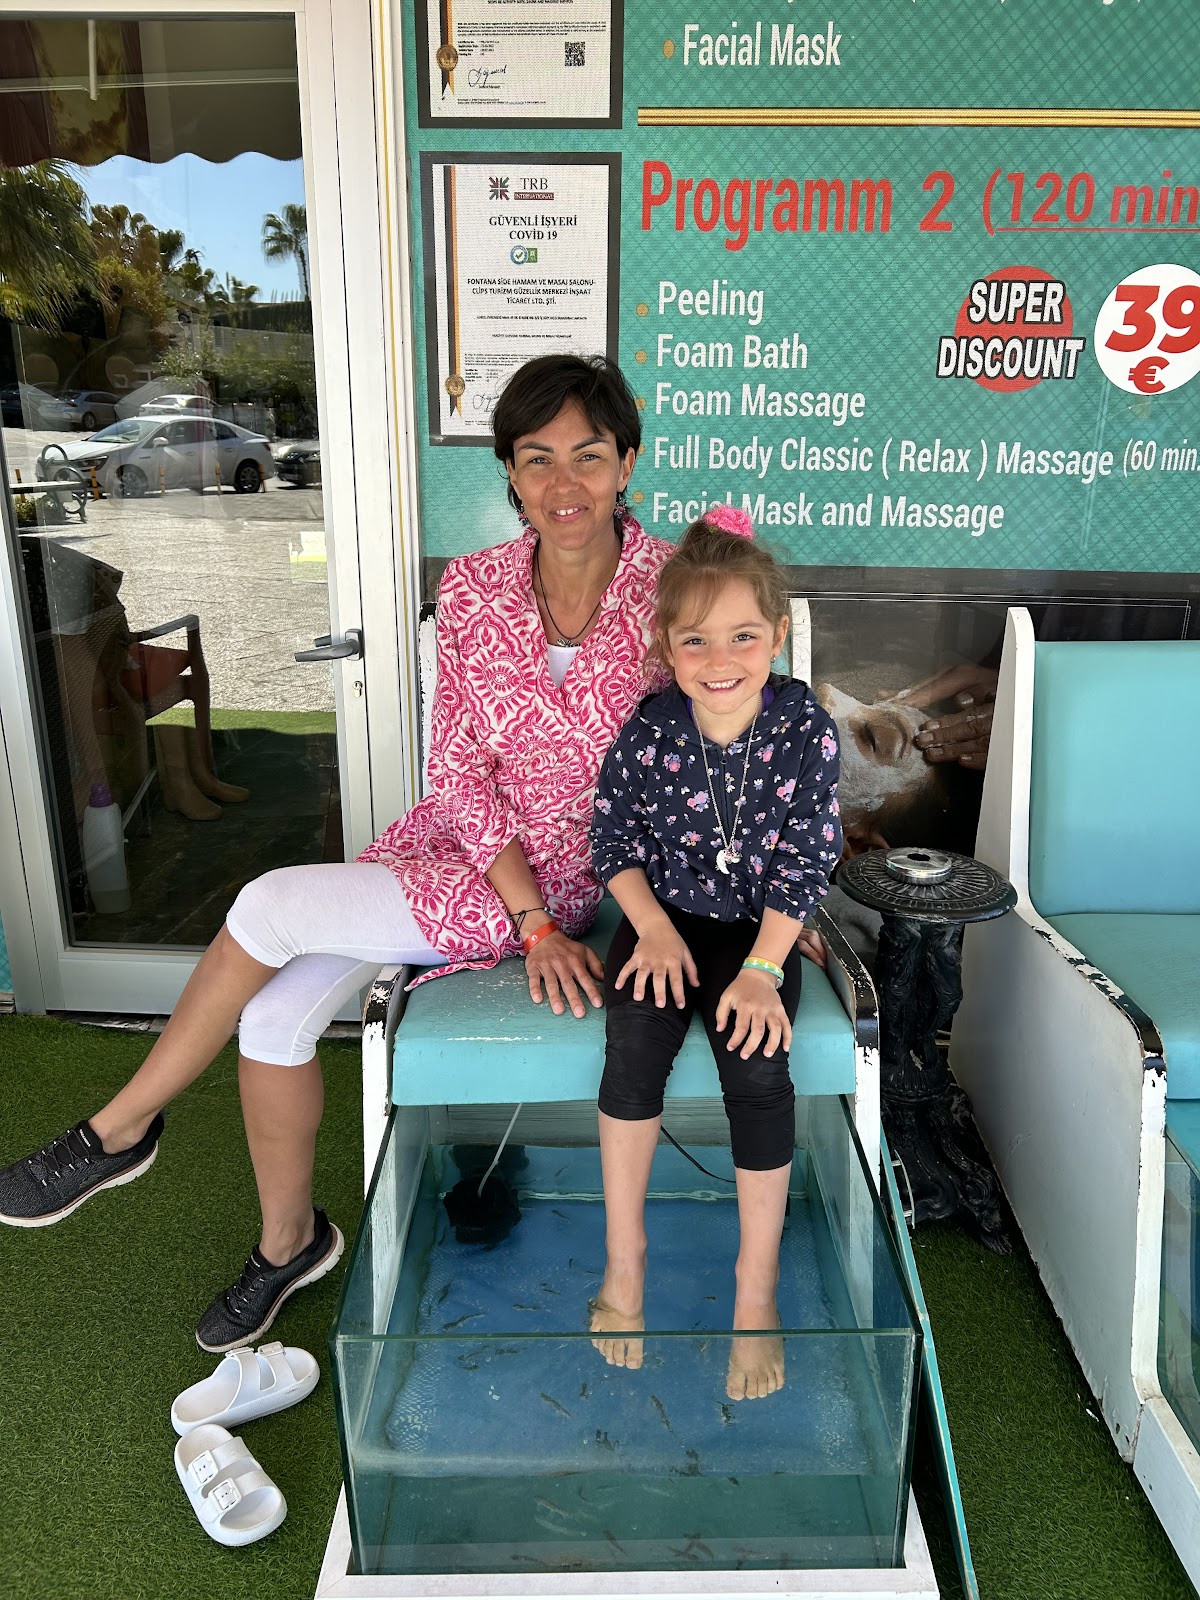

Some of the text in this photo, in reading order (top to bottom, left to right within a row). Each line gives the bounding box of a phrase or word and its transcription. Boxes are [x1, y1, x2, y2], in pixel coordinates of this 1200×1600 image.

[683, 21, 842, 66] Facial Mask
[520, 178, 548, 190] TRB
[641, 160, 893, 251] Programm
[919, 170, 956, 232] 2
[982, 169, 1096, 235] (120
[489, 214, 578, 228] GÜVENLİ İŞYERİ
[548, 230, 557, 240] 19
[512, 278, 537, 286] HAMAM
[658, 279, 764, 325] Peeling
[968, 280, 1066, 324] SUPER
[1104, 285, 1200, 354] 39
[656, 333, 807, 370] Foam Bath
[936, 336, 1086, 380] DISCOUNT
[655, 382, 866, 426] Foam Massage
[654, 435, 700, 470] Full
[708, 436, 774, 478] Body
[780, 437, 873, 473] Classic
[898, 439, 972, 474] Relax
[997, 442, 1113, 485] Massage
[1123, 437, 1157, 478] (60
[741, 492, 814, 526] Mask
[821, 493, 872, 526] and
[882, 495, 1004, 537] Massage
